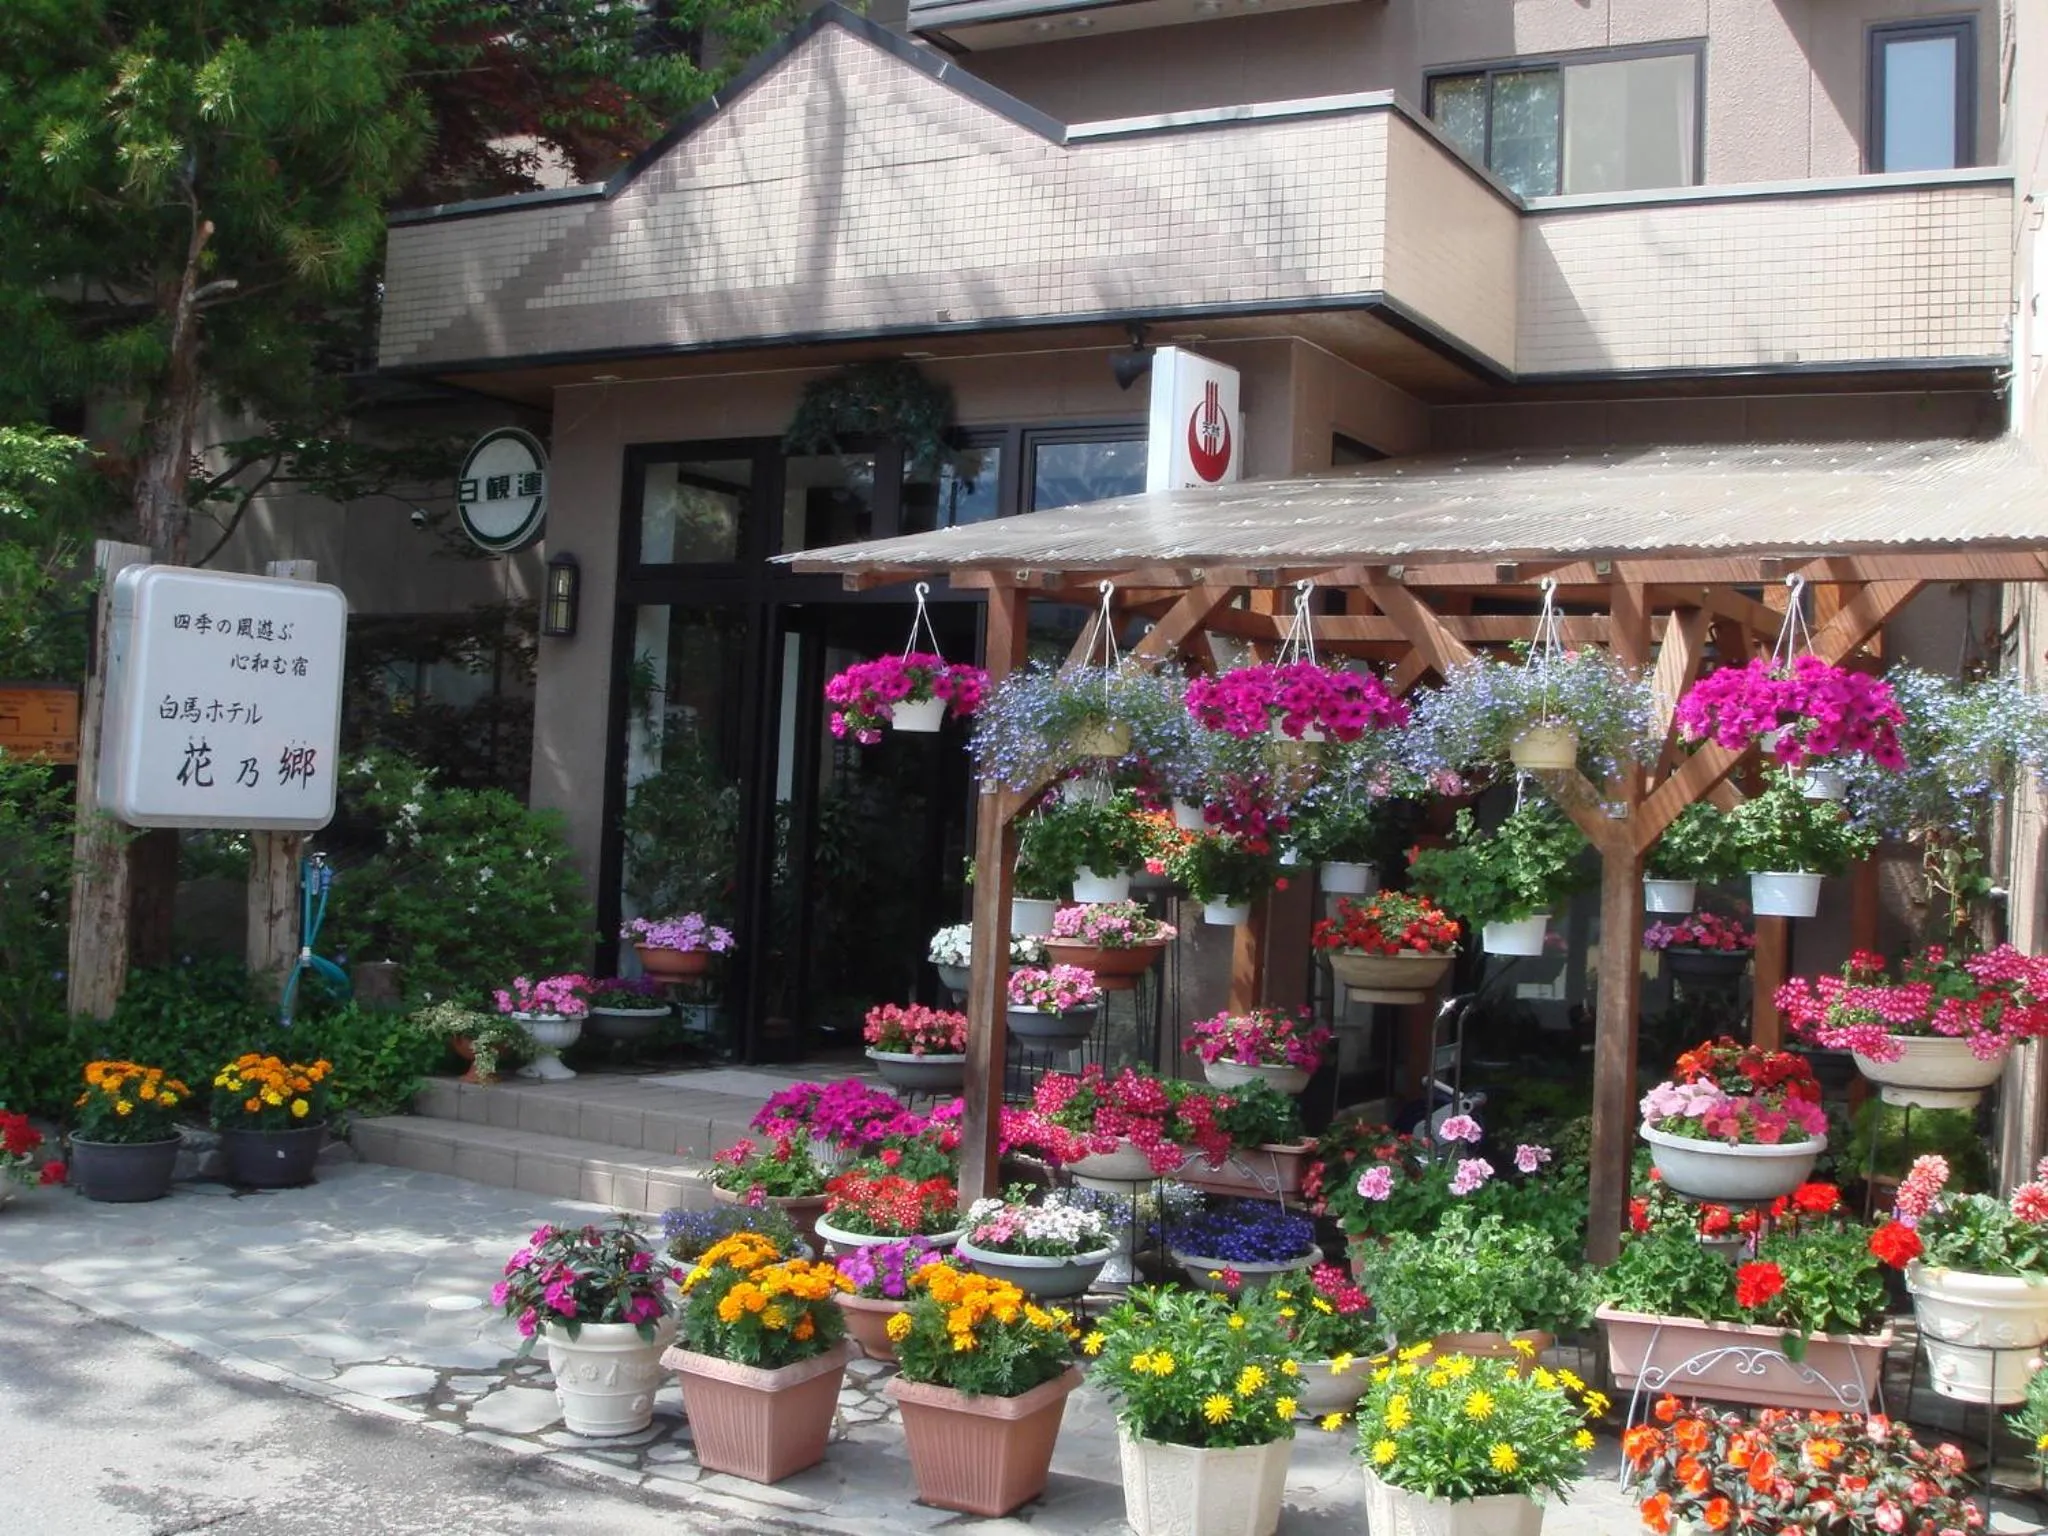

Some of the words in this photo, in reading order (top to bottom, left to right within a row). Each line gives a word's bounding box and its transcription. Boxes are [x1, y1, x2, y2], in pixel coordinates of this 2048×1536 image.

[174, 614, 295, 642] 四季の風遊ぶ
[230, 652, 309, 677] 心和む宿
[159, 694, 263, 725] 白馬ホテル
[176, 741, 318, 790] 花乃郷
